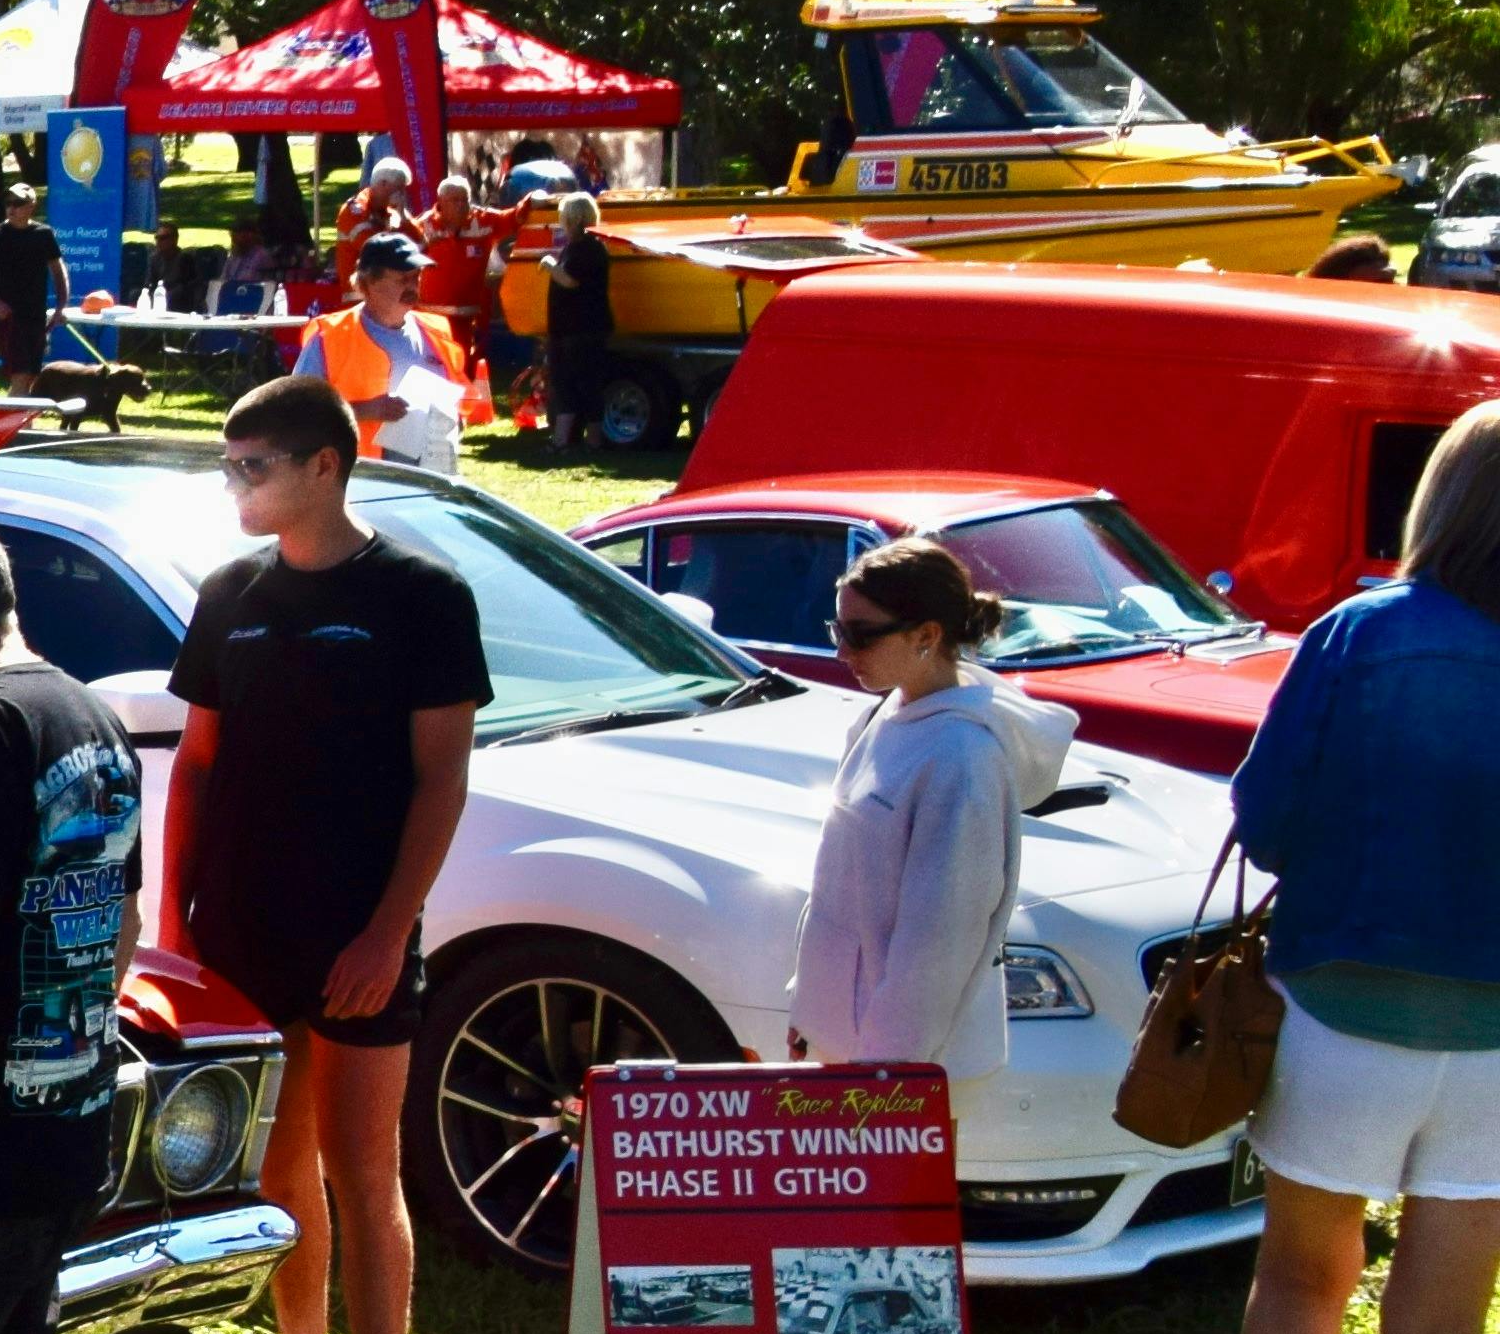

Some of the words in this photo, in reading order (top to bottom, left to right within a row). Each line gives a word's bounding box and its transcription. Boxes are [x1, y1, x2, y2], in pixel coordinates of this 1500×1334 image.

[908, 163, 1008, 191] 457083
[612, 1092, 688, 1118] 1970
[698, 1091, 750, 1118] XW
[613, 1129, 784, 1159] BATHURST
[791, 1126, 945, 1155] WINNING
[616, 1169, 720, 1197] PHASE
[733, 1169, 754, 1195] II
[774, 1167, 868, 1195] GTHO
